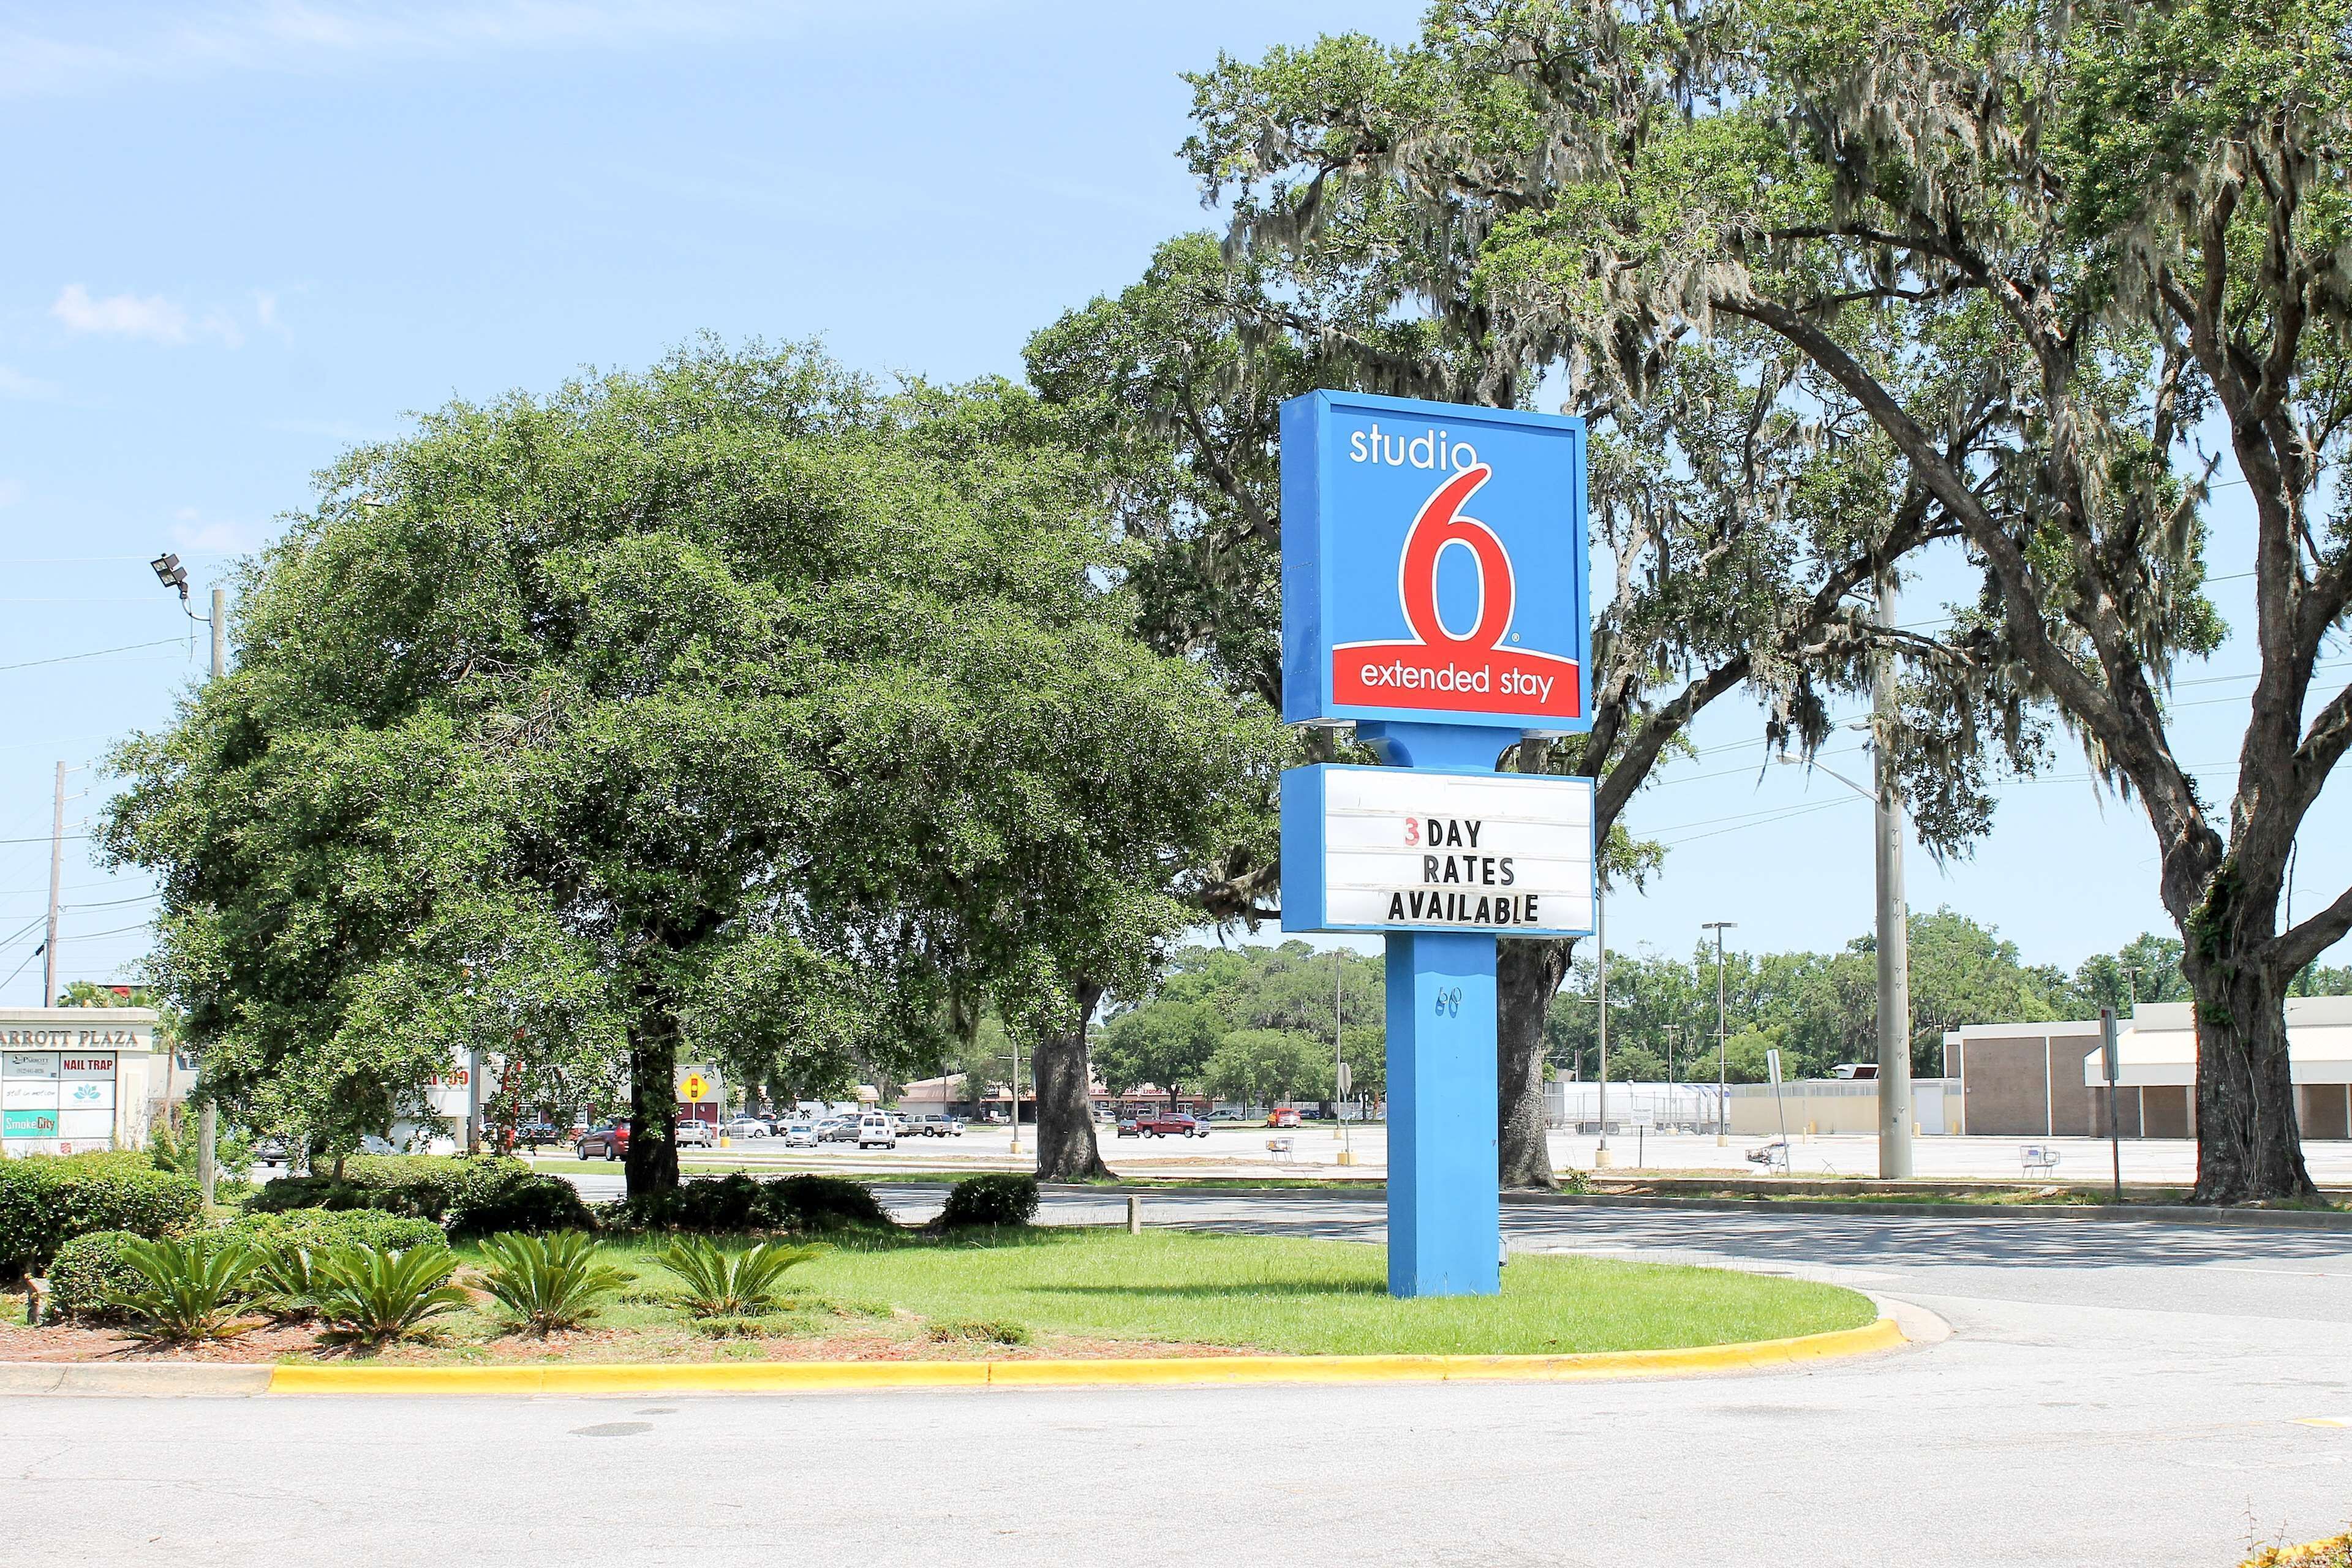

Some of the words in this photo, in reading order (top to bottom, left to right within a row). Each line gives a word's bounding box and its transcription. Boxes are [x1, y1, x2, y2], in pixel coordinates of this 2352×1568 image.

[1349, 423, 1477, 472] studio
[1398, 462, 1516, 647] 6
[1360, 659, 1490, 693] extended
[1500, 667, 1555, 704] stay
[1405, 817, 1420, 846] 3
[1428, 819, 1481, 847] DAY
[1424, 855, 1514, 886] RATES
[1388, 891, 1538, 924] AVAILABLE
[78, 1031, 138, 1045] PLAZA
[64, 1060, 85, 1070] NAIL
[88, 1060, 113, 1070] TRAP
